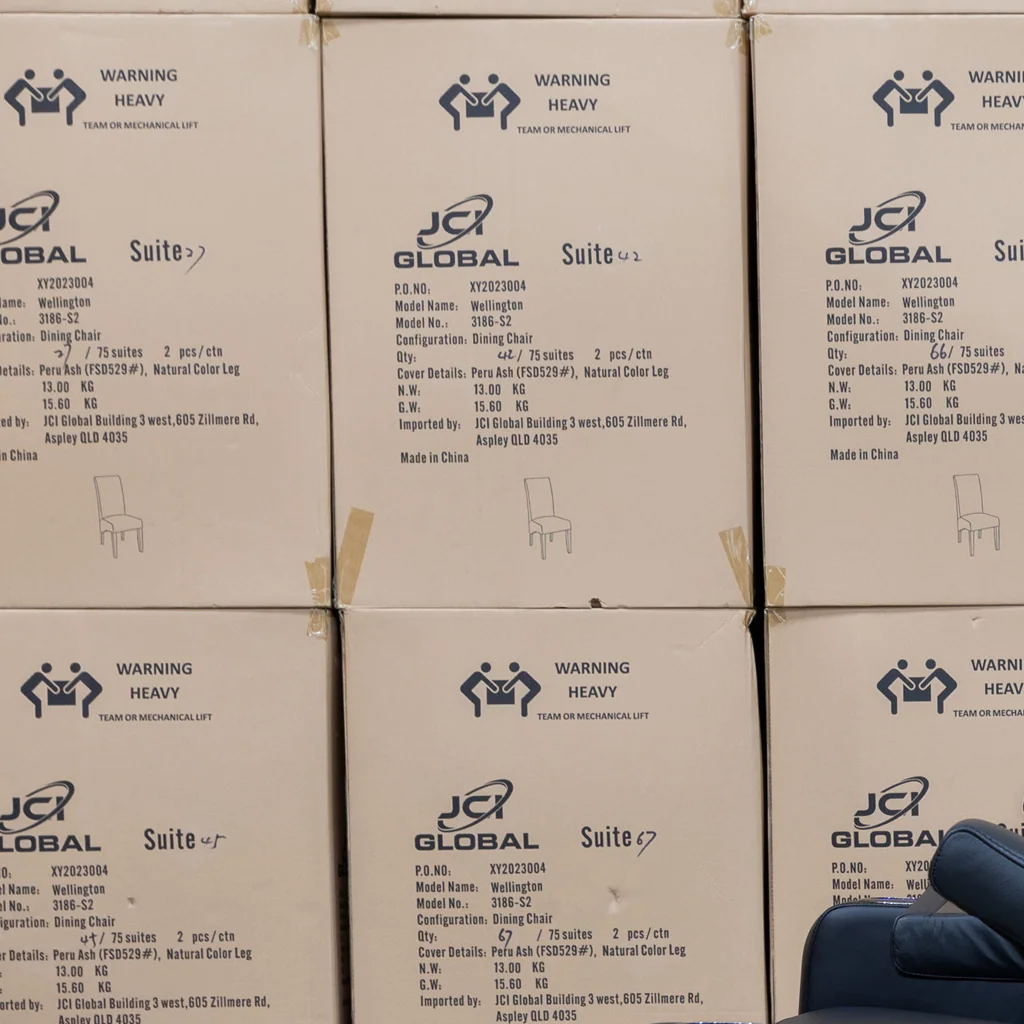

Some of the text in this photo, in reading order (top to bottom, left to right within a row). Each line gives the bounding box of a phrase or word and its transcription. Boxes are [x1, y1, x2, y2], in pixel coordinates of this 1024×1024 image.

[99, 68, 178, 82] WARNING
[534, 73, 611, 87] WARNING
[114, 93, 165, 107] HEAVY
[548, 98, 598, 112] HEAVY
[82, 121, 199, 130] TEAM OR MECHANICAL LIFT
[516, 125, 631, 134] TEAM OR MECHANICAL LIFT
[950, 122, 975, 131] TEAM
[976, 122, 989, 131] OR
[129, 239, 183, 263] Suite
[562, 242, 644, 266] Suite 42
[825, 245, 952, 265] GLOBAL
[393, 249, 520, 269] GLOBAL
[36, 276, 94, 290] XY2023004
[394, 279, 527, 296] P.O.NO: XY2023004
[825, 276, 958, 292] P.O.NO: XY2023004
[37, 296, 91, 311] Wellington
[394, 299, 524, 314] Model Name: Wellington
[395, 331, 534, 348] Configuration: Dining Chair
[827, 364, 856, 377] Cover
[858, 363, 897, 376] Details:
[902, 363, 925, 376] Peru
[926, 362, 945, 375] Ash
[947, 361, 1009, 376] (FSD529#),
[44, 430, 128, 446] Aspley QLD 4035
[116, 662, 193, 676] WARNING
[554, 661, 630, 675] WARNING
[130, 686, 180, 700] HEAVY
[568, 685, 618, 699] HEAVY
[98, 713, 213, 722] TEAM OR MECHANICAL LIFT
[536, 711, 650, 721] TEAM OR MECHANICAL LIFT
[952, 709, 978, 718] TEAM
[978, 709, 992, 718] OR
[143, 827, 228, 851] Suite 45
[414, 832, 540, 851] GLOBAL
[581, 825, 657, 859] Suite 67
[50, 864, 109, 878] XY2023004
[415, 861, 546, 877] P.O.NO: XY2023004
[831, 861, 867, 874] P.O.NO:
[51, 883, 106, 898] Wellington
[832, 878, 861, 890] Model
[863, 878, 894, 890] Name:
[52, 898, 94, 912] 3186-S2
[420, 994, 465, 1009] Imported
[466, 994, 482, 1009] by:
[495, 994, 510, 1006] JCI
[512, 993, 543, 1006] Global
[545, 993, 587, 1008] Building
[588, 992, 595, 1005] 3
[644, 992, 685, 1005] Zillmere
[687, 992, 704, 1005] Rd,
